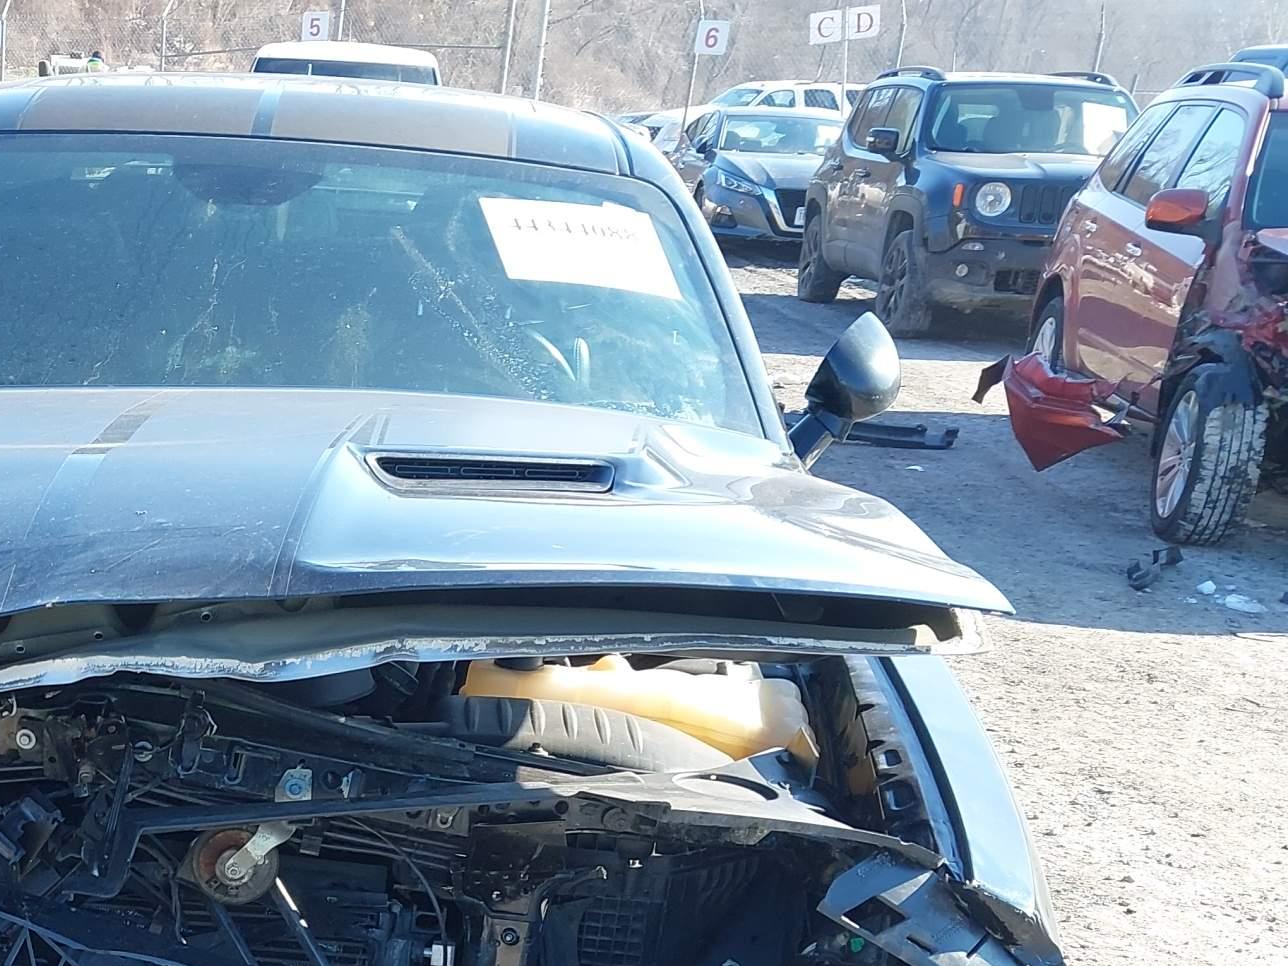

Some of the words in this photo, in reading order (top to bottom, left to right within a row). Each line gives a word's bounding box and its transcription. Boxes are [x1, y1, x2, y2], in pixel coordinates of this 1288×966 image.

[309, 17, 321, 37] 5
[817, 16, 834, 38] C
[855, 12, 874, 34] D
[704, 27, 719, 48] 6
